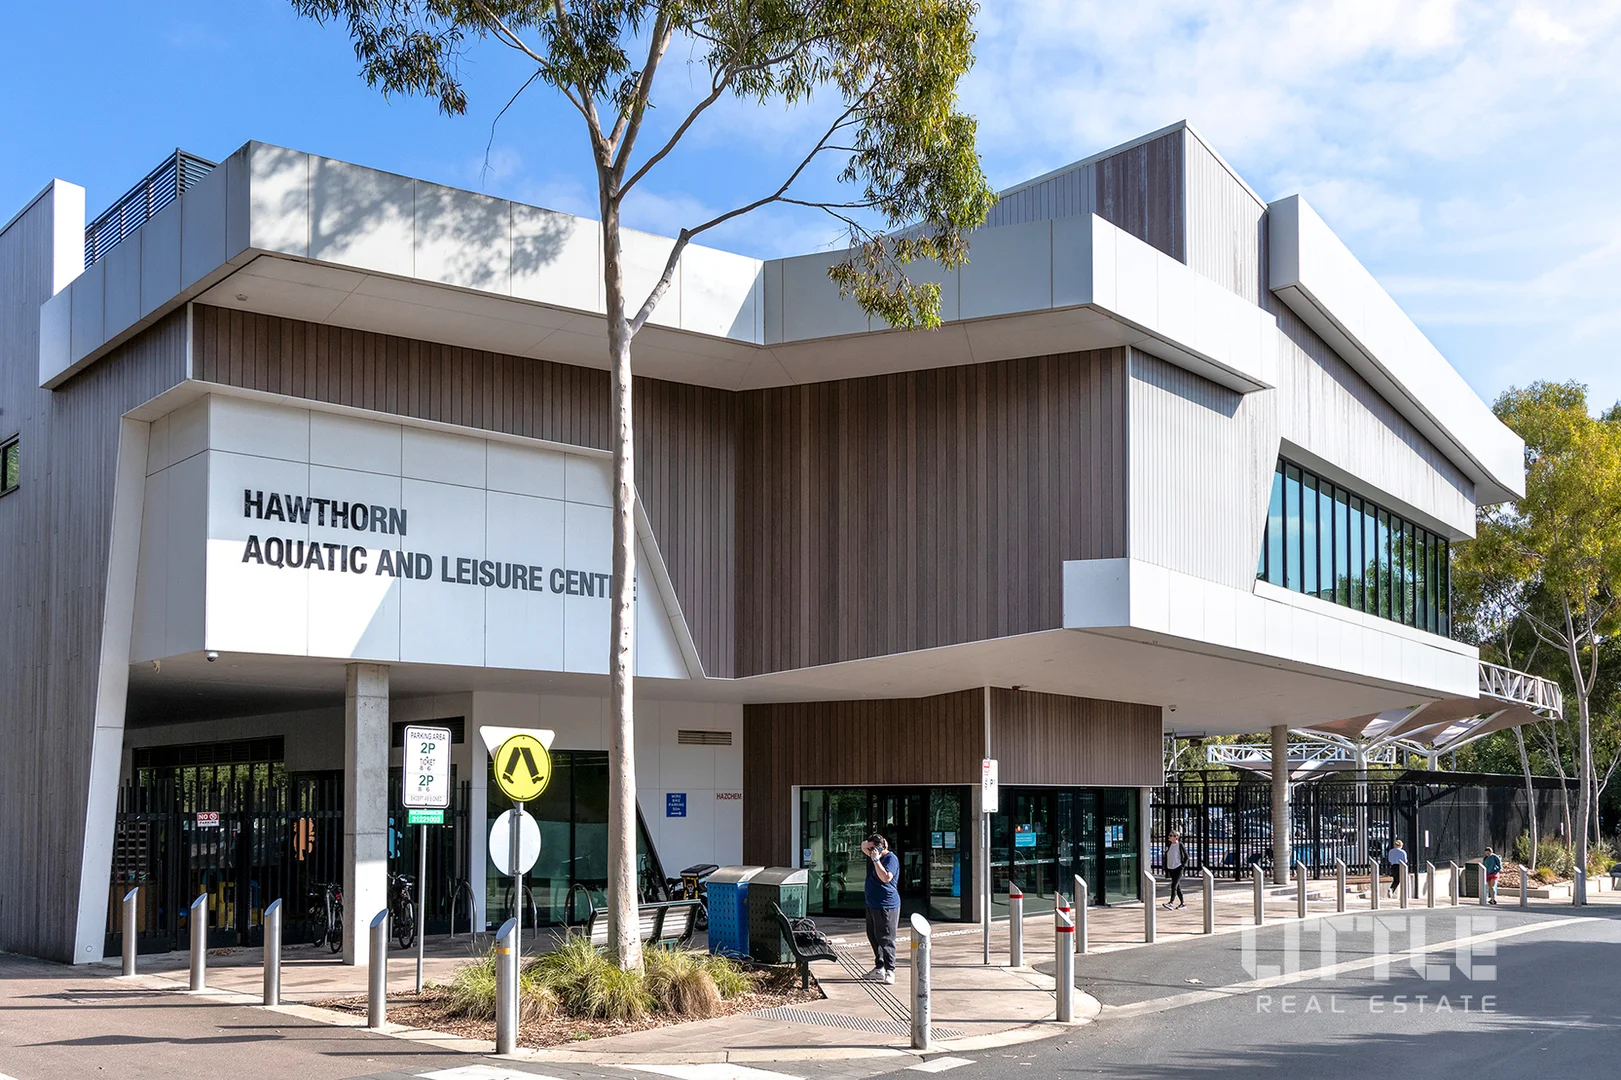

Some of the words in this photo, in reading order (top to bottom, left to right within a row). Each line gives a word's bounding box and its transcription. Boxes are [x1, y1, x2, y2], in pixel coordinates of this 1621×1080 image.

[244, 489, 407, 536] HAWTHORN
[242, 535, 368, 574] AQUATIC
[375, 549, 433, 580] AND
[441, 556, 543, 592] LEISURE
[549, 568, 637, 602] CENT
[410, 731, 432, 740] PARKING
[432, 733, 446, 741] AREA
[420, 742, 436, 754] 2P
[418, 774, 434, 786] 2P
